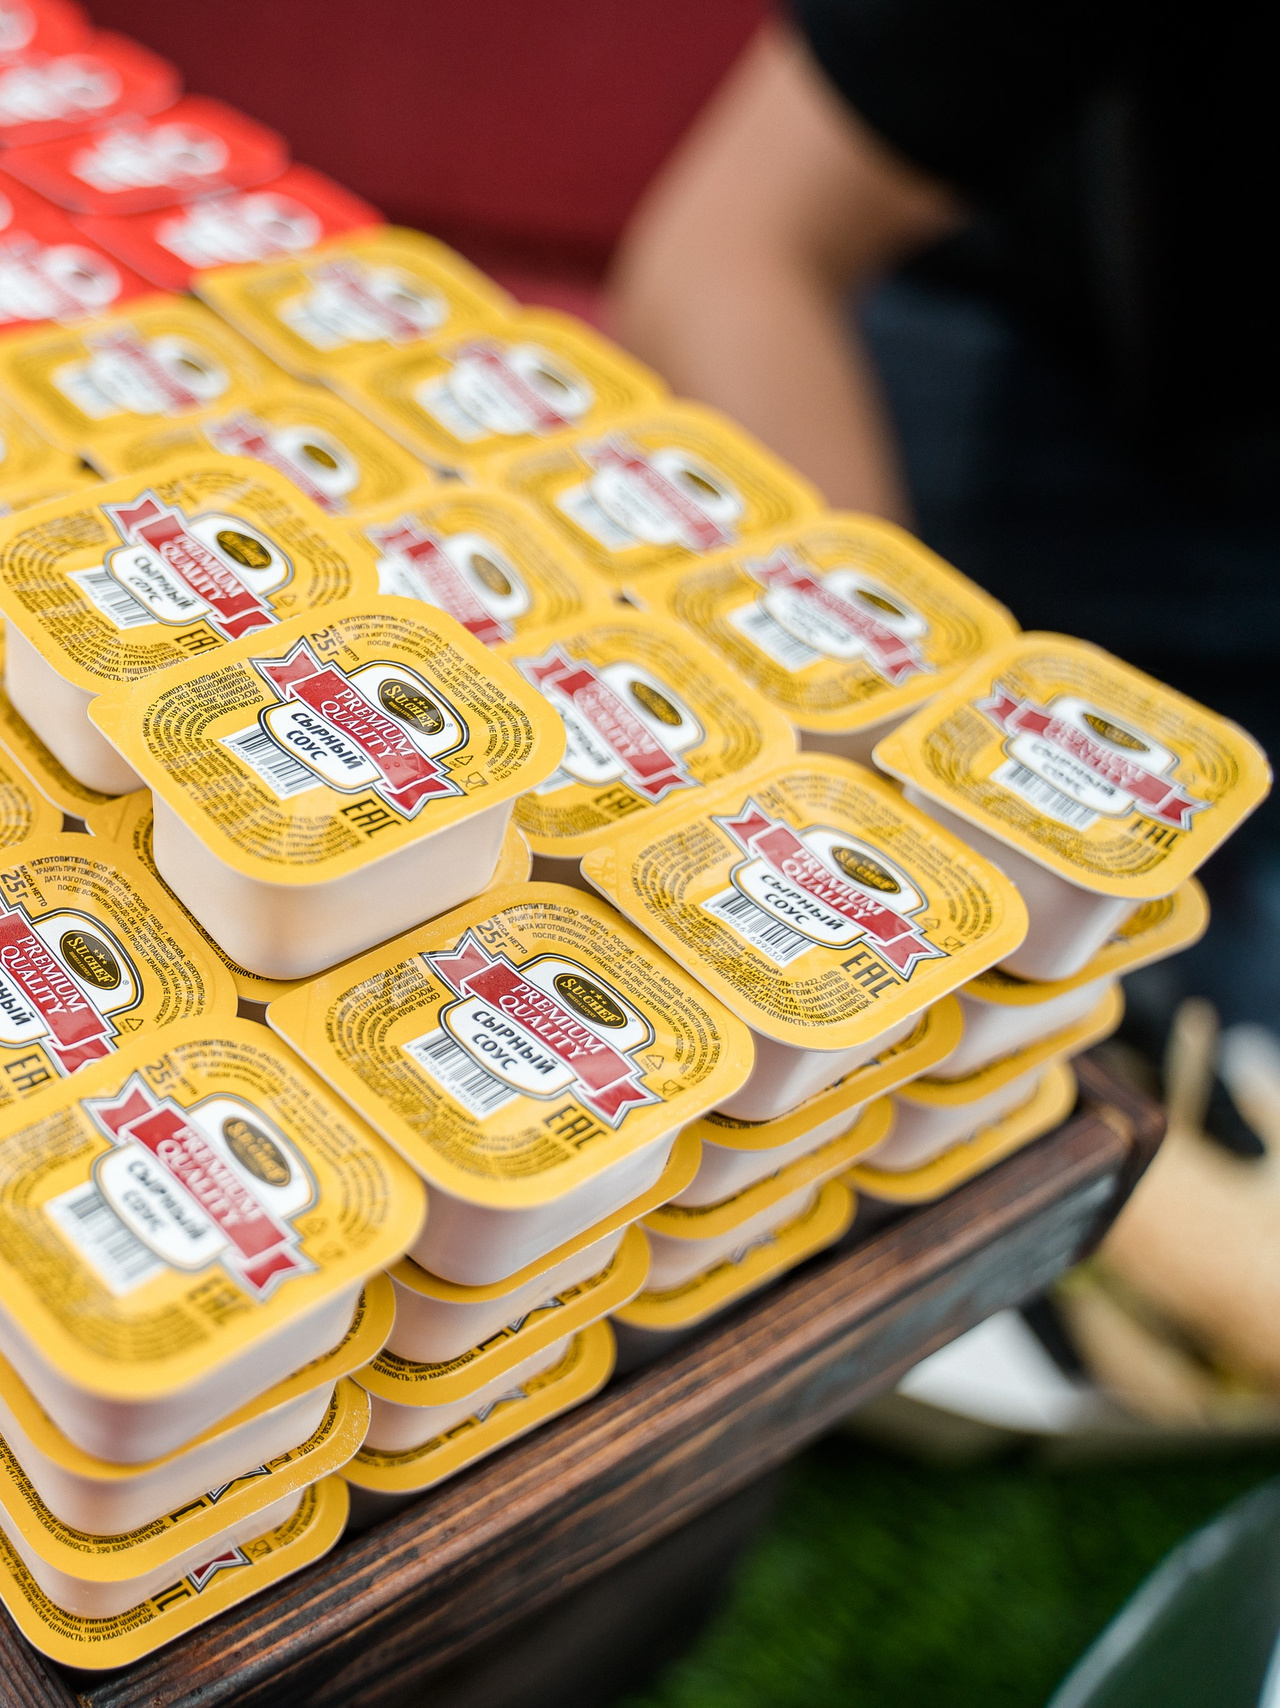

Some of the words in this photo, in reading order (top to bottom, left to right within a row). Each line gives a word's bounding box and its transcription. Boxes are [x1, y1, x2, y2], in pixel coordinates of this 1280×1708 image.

[307, 628, 339, 653] 25
[283, 727, 328, 763] СОУС
[288, 708, 368, 771] СЫРНЫЙ
[315, 696, 399, 761] QUALITY
[332, 687, 418, 758] PREMIUM
[29, 885, 48, 908] НЕТТО
[91, 861, 109, 873] ООО
[164, 935, 187, 961] МОСКВА,
[757, 871, 847, 932] СЫРНЫЙ
[762, 890, 811, 926] СОУС
[775, 856, 872, 922] QUALITY
[789, 846, 886, 916] PREMIUM
[65, 934, 116, 982] S.U.CHEF
[126, 932, 151, 959] ПРОДУКТ
[144, 955, 170, 987] ХРАНЕНИЮ
[474, 918, 505, 945] 25
[505, 935, 530, 955] НЕТТО
[14, 932, 89, 1014] PREMIUM
[558, 976, 622, 1023] S.U.CHEF
[469, 1008, 560, 1076] СЫРНЫЙ
[494, 992, 588, 1062] QUALITY
[508, 980, 607, 1056] PREMIUM
[468, 1030, 519, 1072] СОУС
